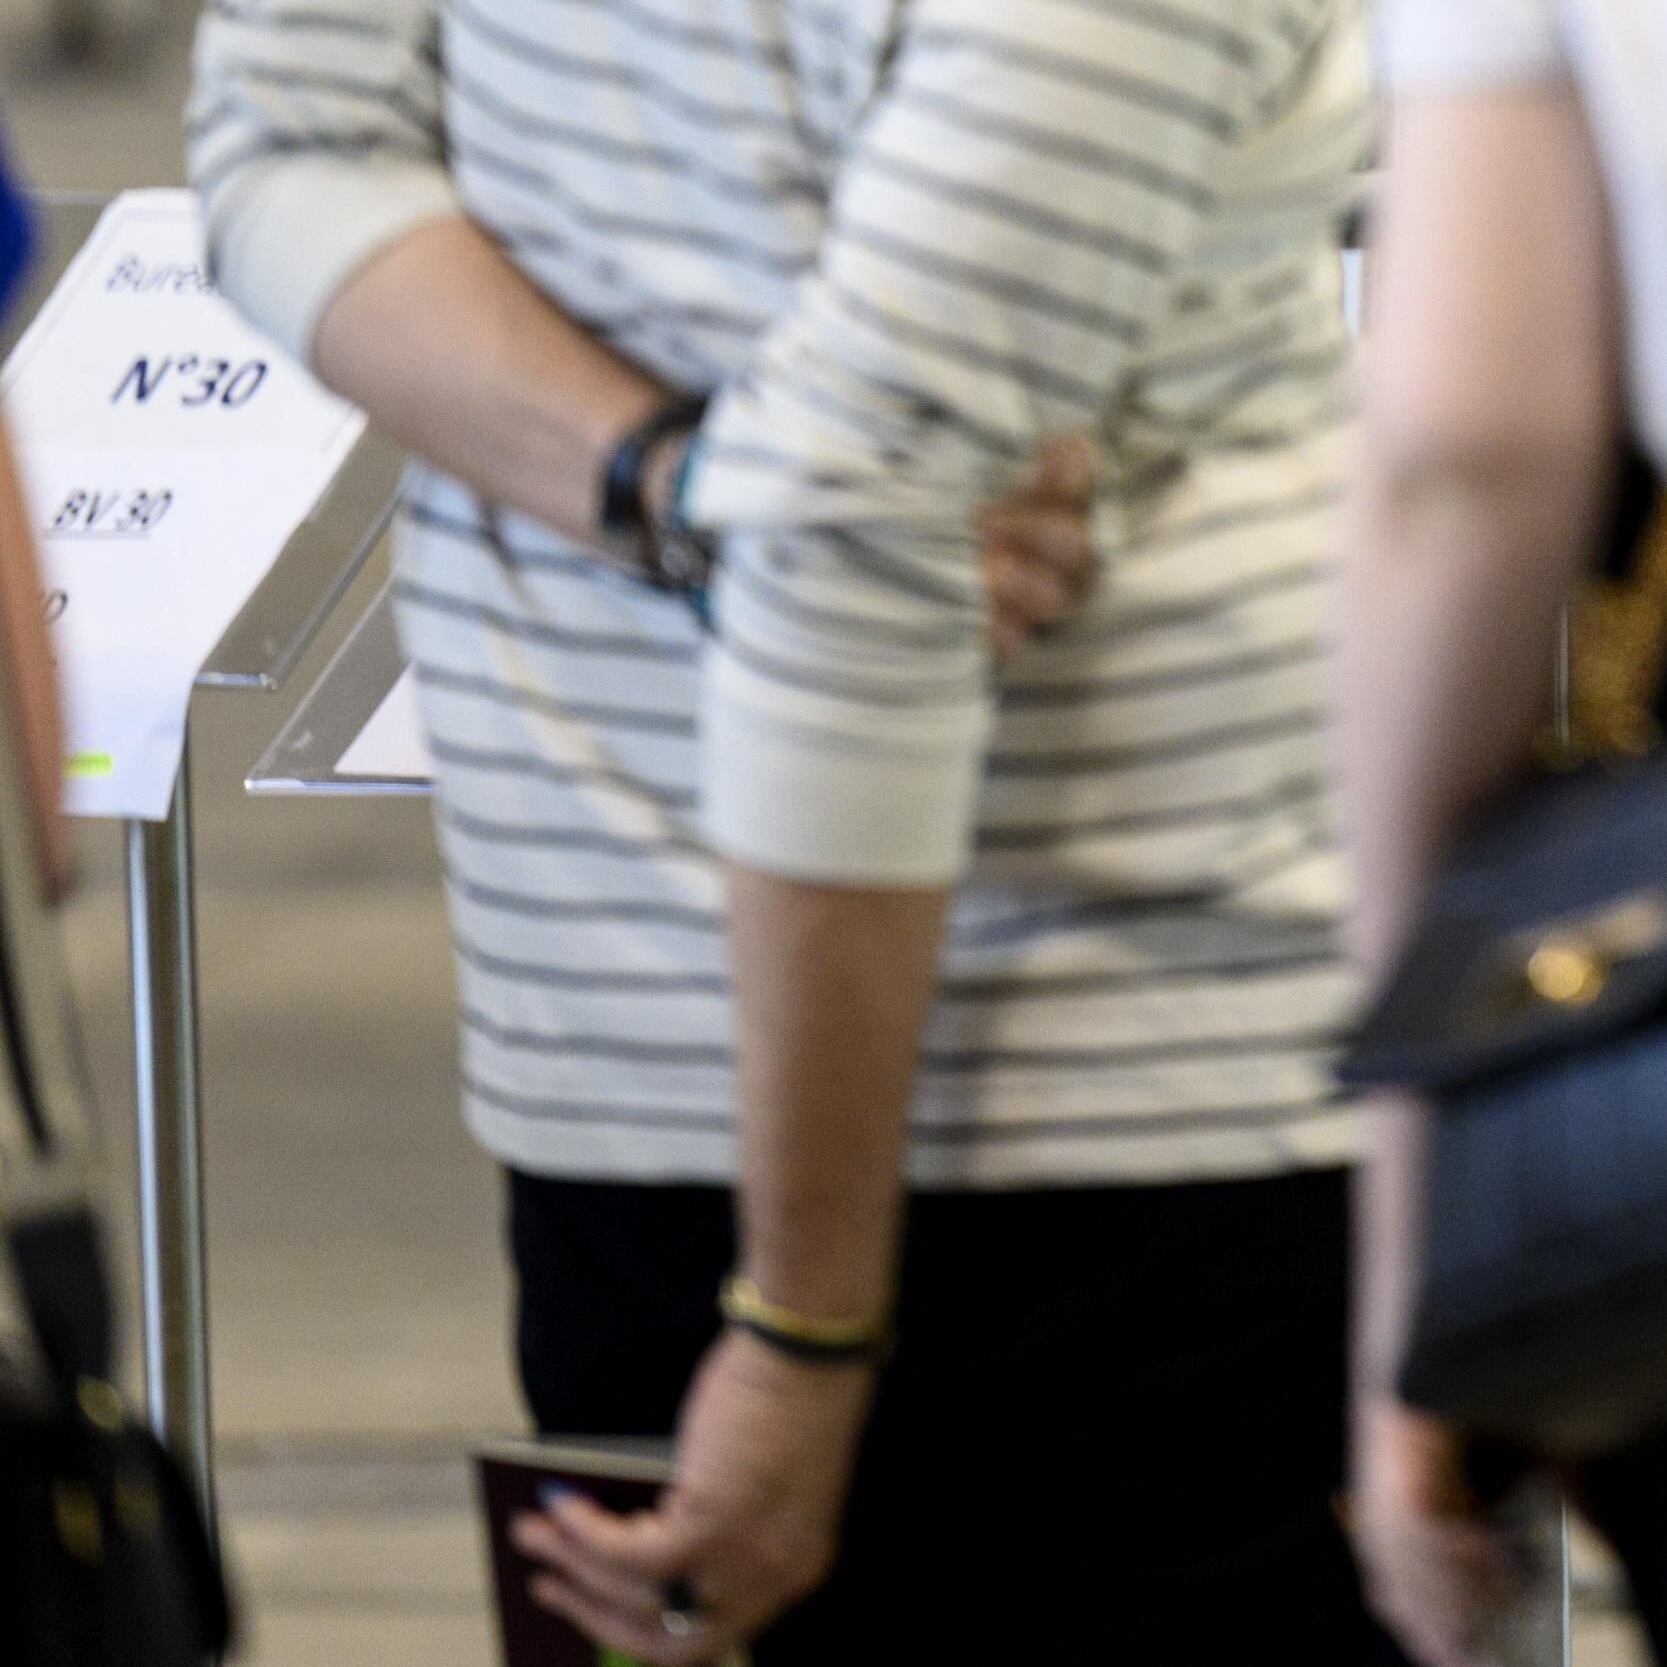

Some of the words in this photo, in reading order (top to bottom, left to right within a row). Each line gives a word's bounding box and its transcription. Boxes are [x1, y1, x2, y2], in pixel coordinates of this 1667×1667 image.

[111, 351, 269, 408] N°30
[53, 490, 117, 530] BV
[117, 488, 174, 532] 30
